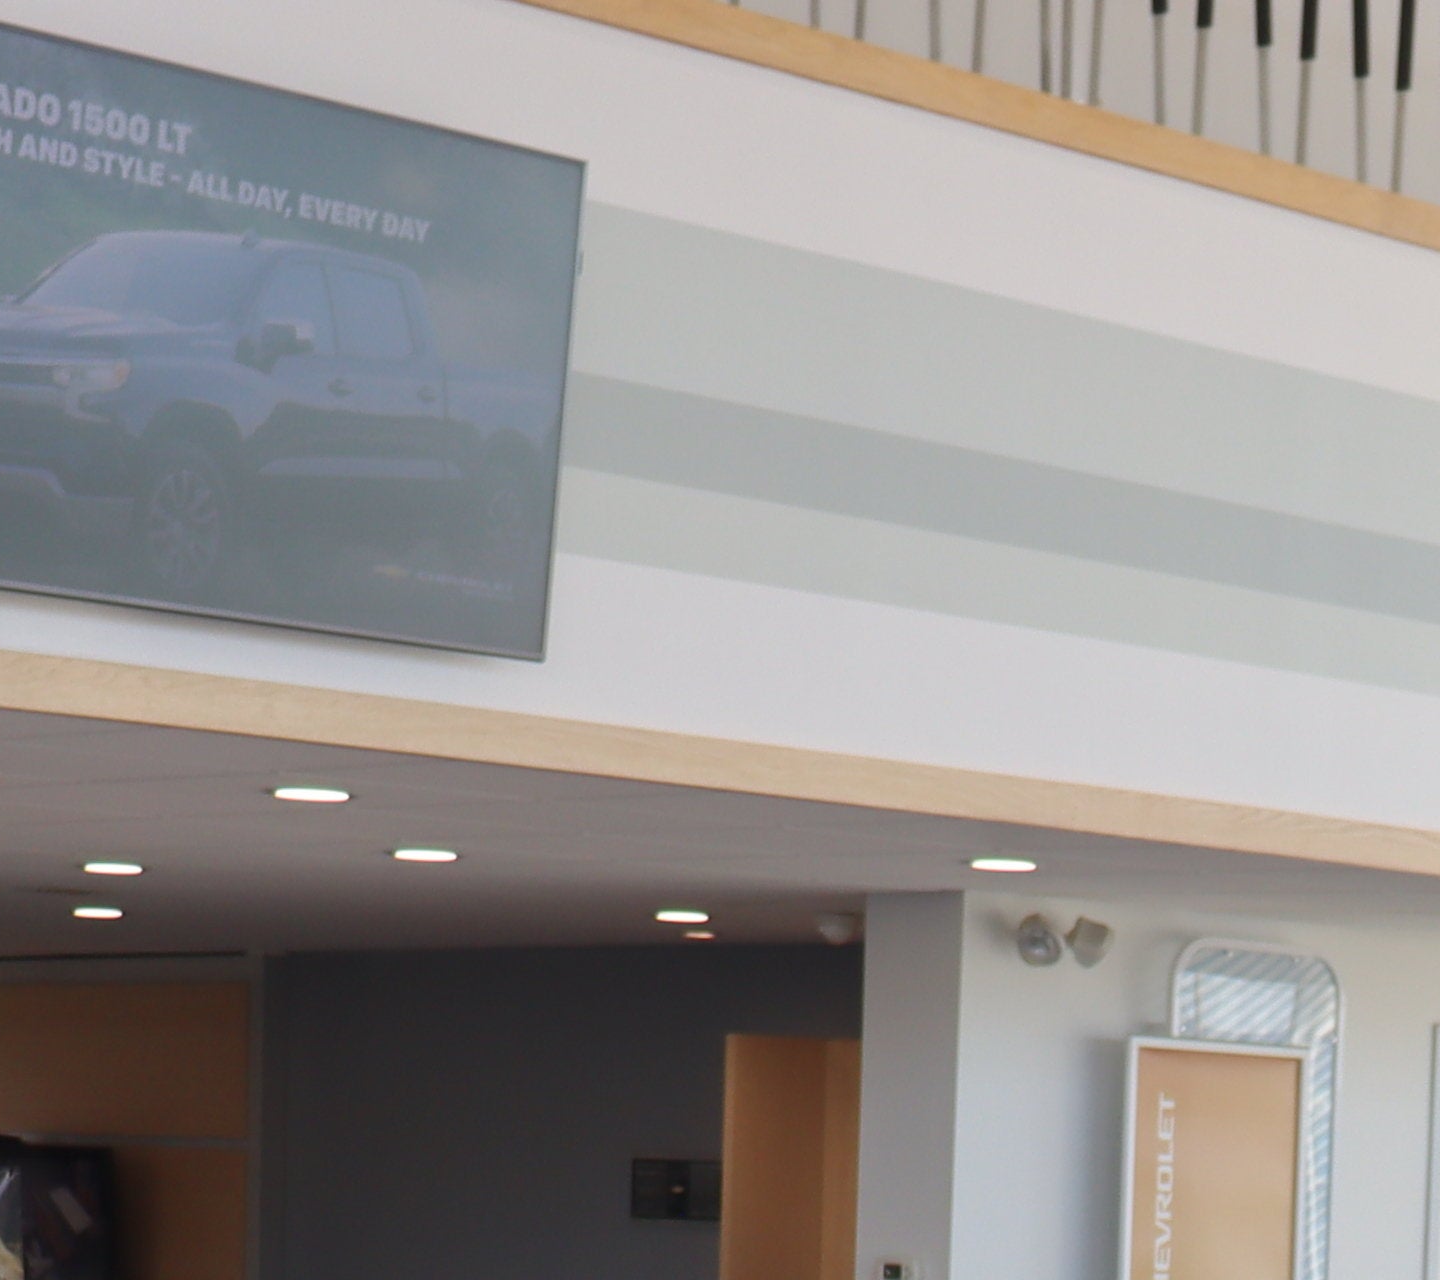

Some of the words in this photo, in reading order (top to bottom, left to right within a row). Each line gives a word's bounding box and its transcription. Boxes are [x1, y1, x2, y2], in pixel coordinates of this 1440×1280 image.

[68, 99, 151, 147] 1500
[158, 119, 192, 155] LT
[18, 133, 79, 168] AND
[84, 147, 164, 187] STYLE
[186, 169, 233, 201] ALL
[237, 180, 291, 219] DAY,
[298, 194, 380, 232] EVERY
[382, 215, 432, 243] DAY
